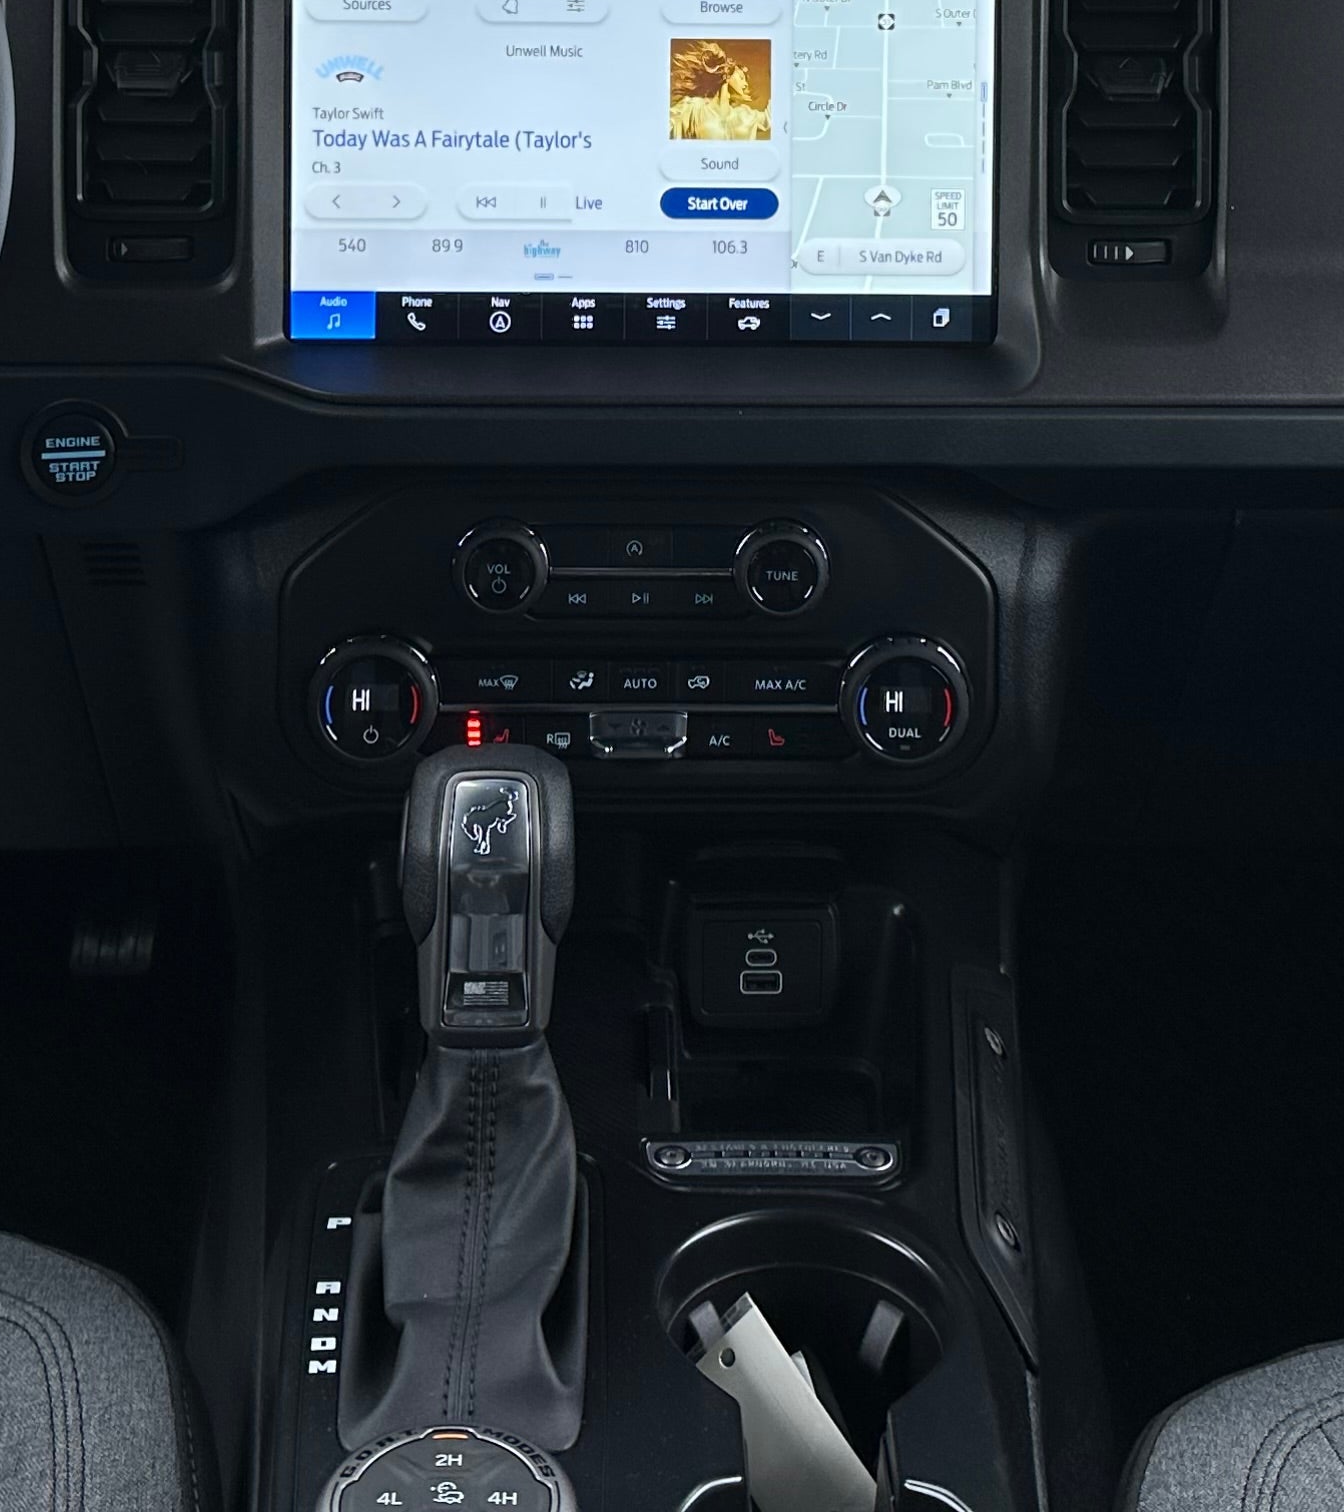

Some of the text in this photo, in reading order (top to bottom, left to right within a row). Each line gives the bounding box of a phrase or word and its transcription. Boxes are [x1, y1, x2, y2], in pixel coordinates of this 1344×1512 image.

[700, 1, 743, 14] Browse
[506, 46, 583, 58] Unwell Music
[814, 51, 827, 59] Rd
[951, 81, 972, 89] Blvd
[808, 102, 847, 111] Circle Dr
[312, 108, 384, 121] Taylor Swift
[313, 130, 592, 151] Today Was A Fairytale (Taylor's
[312, 162, 340, 174] Ch. 3
[701, 158, 739, 171] Sound
[934, 192, 962, 200] SPEED
[576, 197, 603, 210] Live
[688, 197, 748, 210] Start Over
[936, 202, 959, 210] LIMIT
[938, 213, 957, 226] 50
[338, 239, 366, 252] 540
[625, 241, 649, 253] 810
[712, 241, 748, 254] 106.3
[817, 250, 824, 262] E
[859, 251, 942, 265] S Van Dyke Rd
[320, 296, 347, 307] Audio
[402, 297, 432, 307] Phone
[491, 297, 510, 308] Nav
[572, 297, 596, 309] Apps
[646, 298, 686, 310] Settings
[729, 298, 770, 309] Features
[45, 436, 101, 449] ENGINE
[49, 461, 100, 472] START
[55, 471, 96, 483] STOP
[487, 564, 510, 575] VOL
[766, 570, 799, 581] TUNE
[478, 677, 499, 687] MAX
[623, 678, 657, 689] AUTO
[755, 680, 806, 690] MAX A/C
[352, 689, 370, 711] HI
[885, 691, 903, 713] HI
[888, 728, 921, 738] DUAL
[709, 735, 730, 747] A/C
[327, 1217, 352, 1229] P
[313, 1308, 339, 1321] N
[310, 1337, 337, 1351] D
[308, 1360, 337, 1374] M
[482, 1428, 556, 1478] MODES
[435, 1454, 463, 1467] 2H
[376, 1493, 403, 1506] 4L
[487, 1492, 518, 1505] 4H
